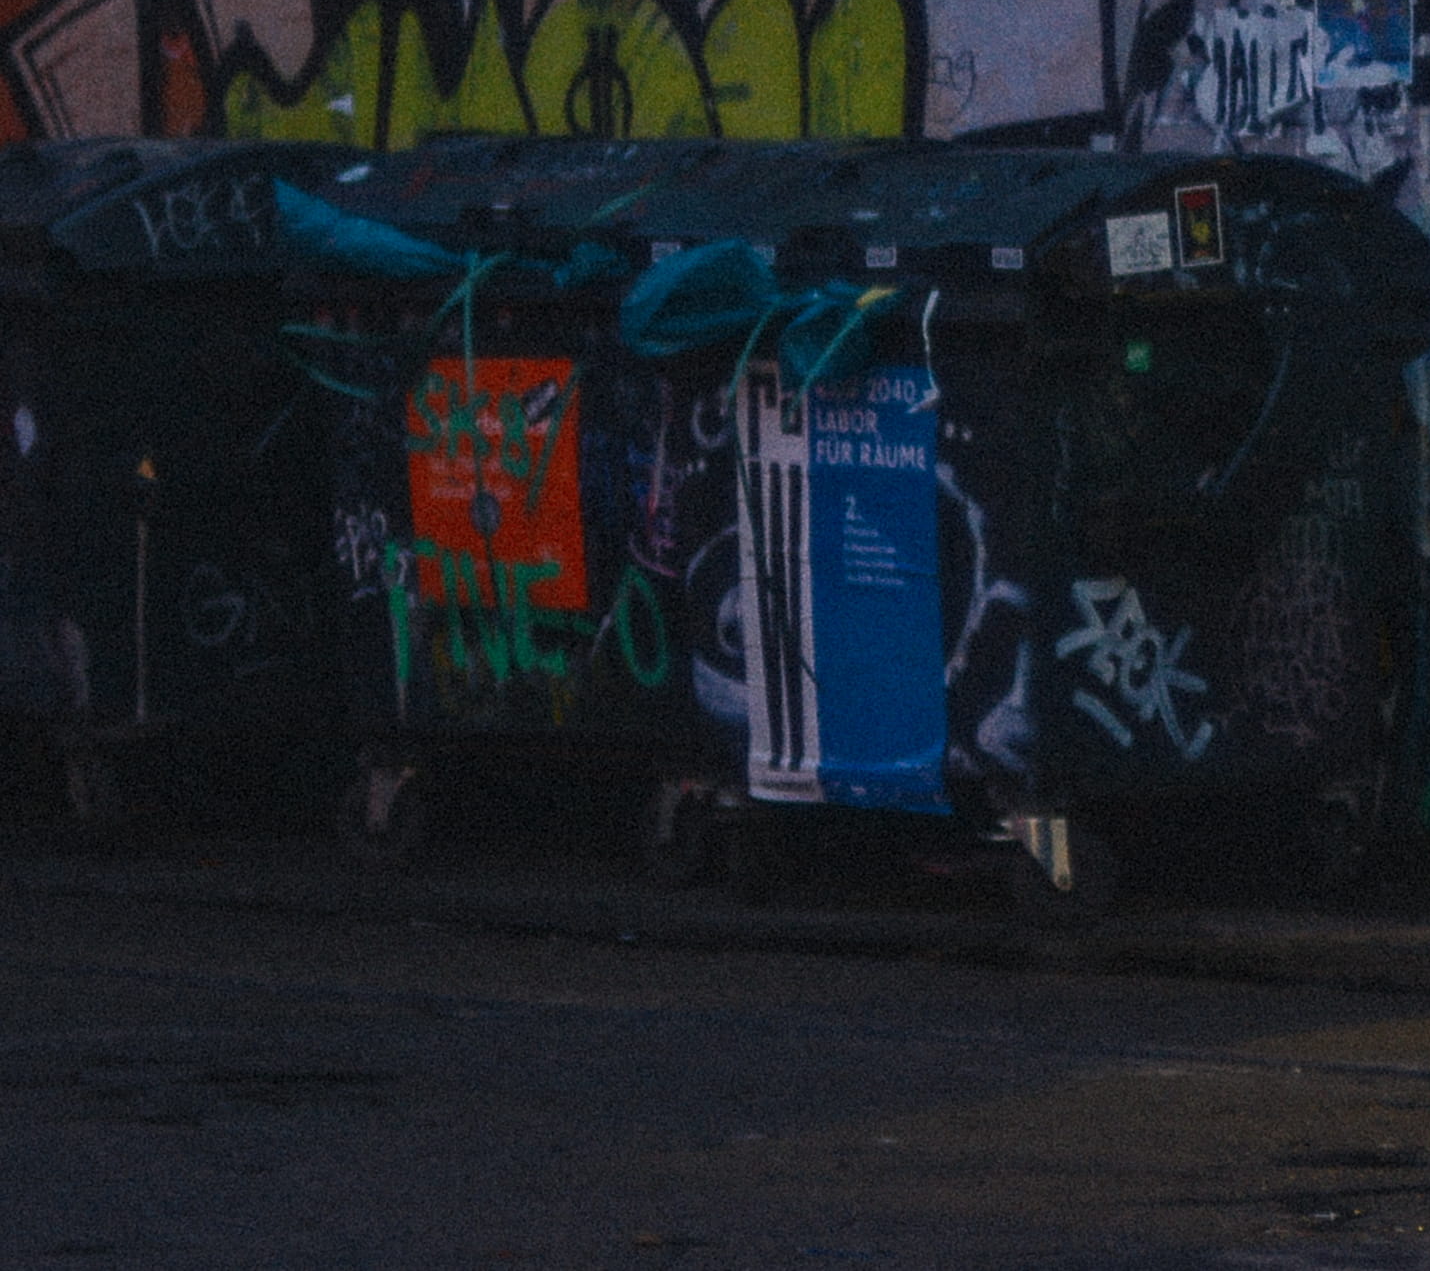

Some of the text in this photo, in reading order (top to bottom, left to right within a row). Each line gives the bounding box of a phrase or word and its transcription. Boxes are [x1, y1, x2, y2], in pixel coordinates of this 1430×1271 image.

[815, 408, 879, 434] LABOR
[815, 434, 927, 470] FÜR RÄUME
